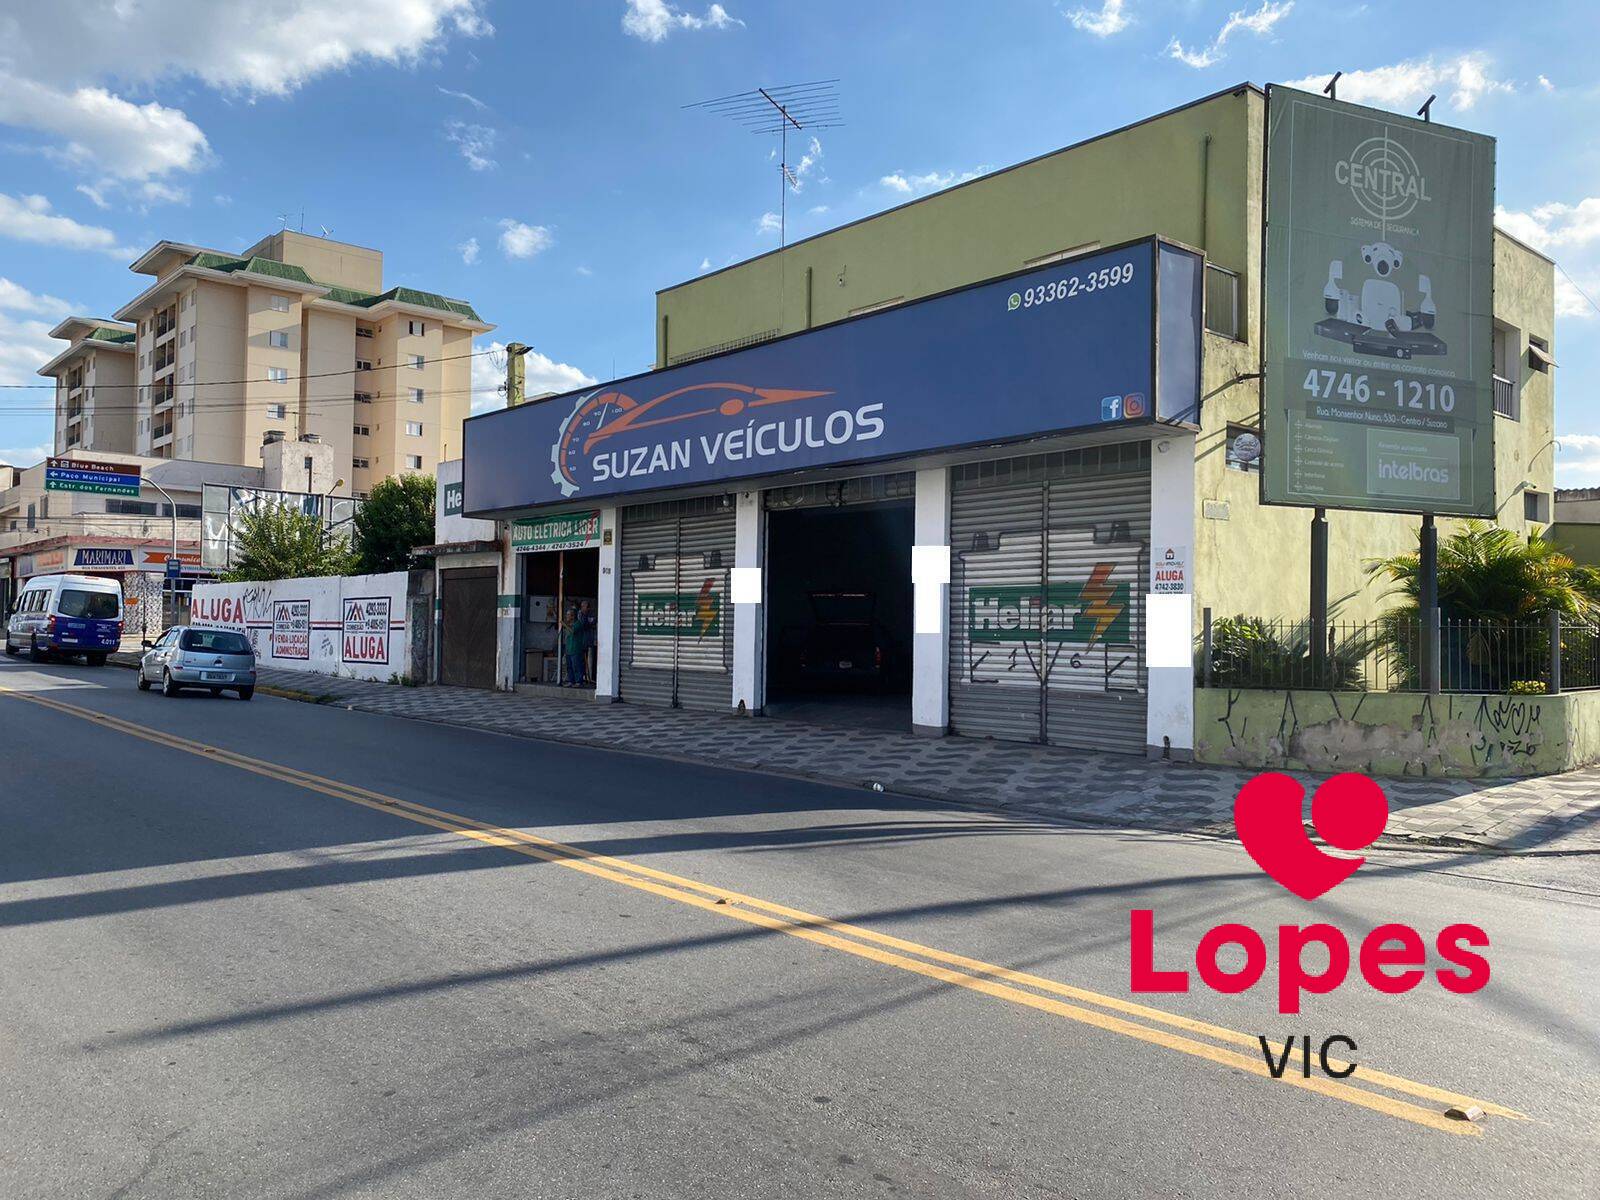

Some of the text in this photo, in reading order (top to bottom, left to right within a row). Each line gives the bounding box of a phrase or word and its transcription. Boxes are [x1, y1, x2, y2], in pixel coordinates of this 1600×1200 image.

[1335, 160, 1432, 202] CENTRAL
[1023, 263, 1134, 308] 93362-3599
[1303, 368, 1371, 404] 4746
[1394, 378, 1455, 413] 1210
[592, 402, 885, 482] SUZAN VEÍCULOS
[71, 462, 114, 472] Blue Beach
[82, 474, 120, 483] Municipal
[1378, 458, 1449, 484] intelbras
[95, 485, 135, 494] Fernandes
[512, 525, 533, 540] AUTO
[82, 550, 127, 564] MARIMARI
[1155, 570, 1184, 581] ALUGA
[191, 598, 244, 623] ALUGA
[640, 602, 697, 628] Heliar
[973, 596, 1082, 631] Heliar
[344, 636, 385, 660] ALUGA
